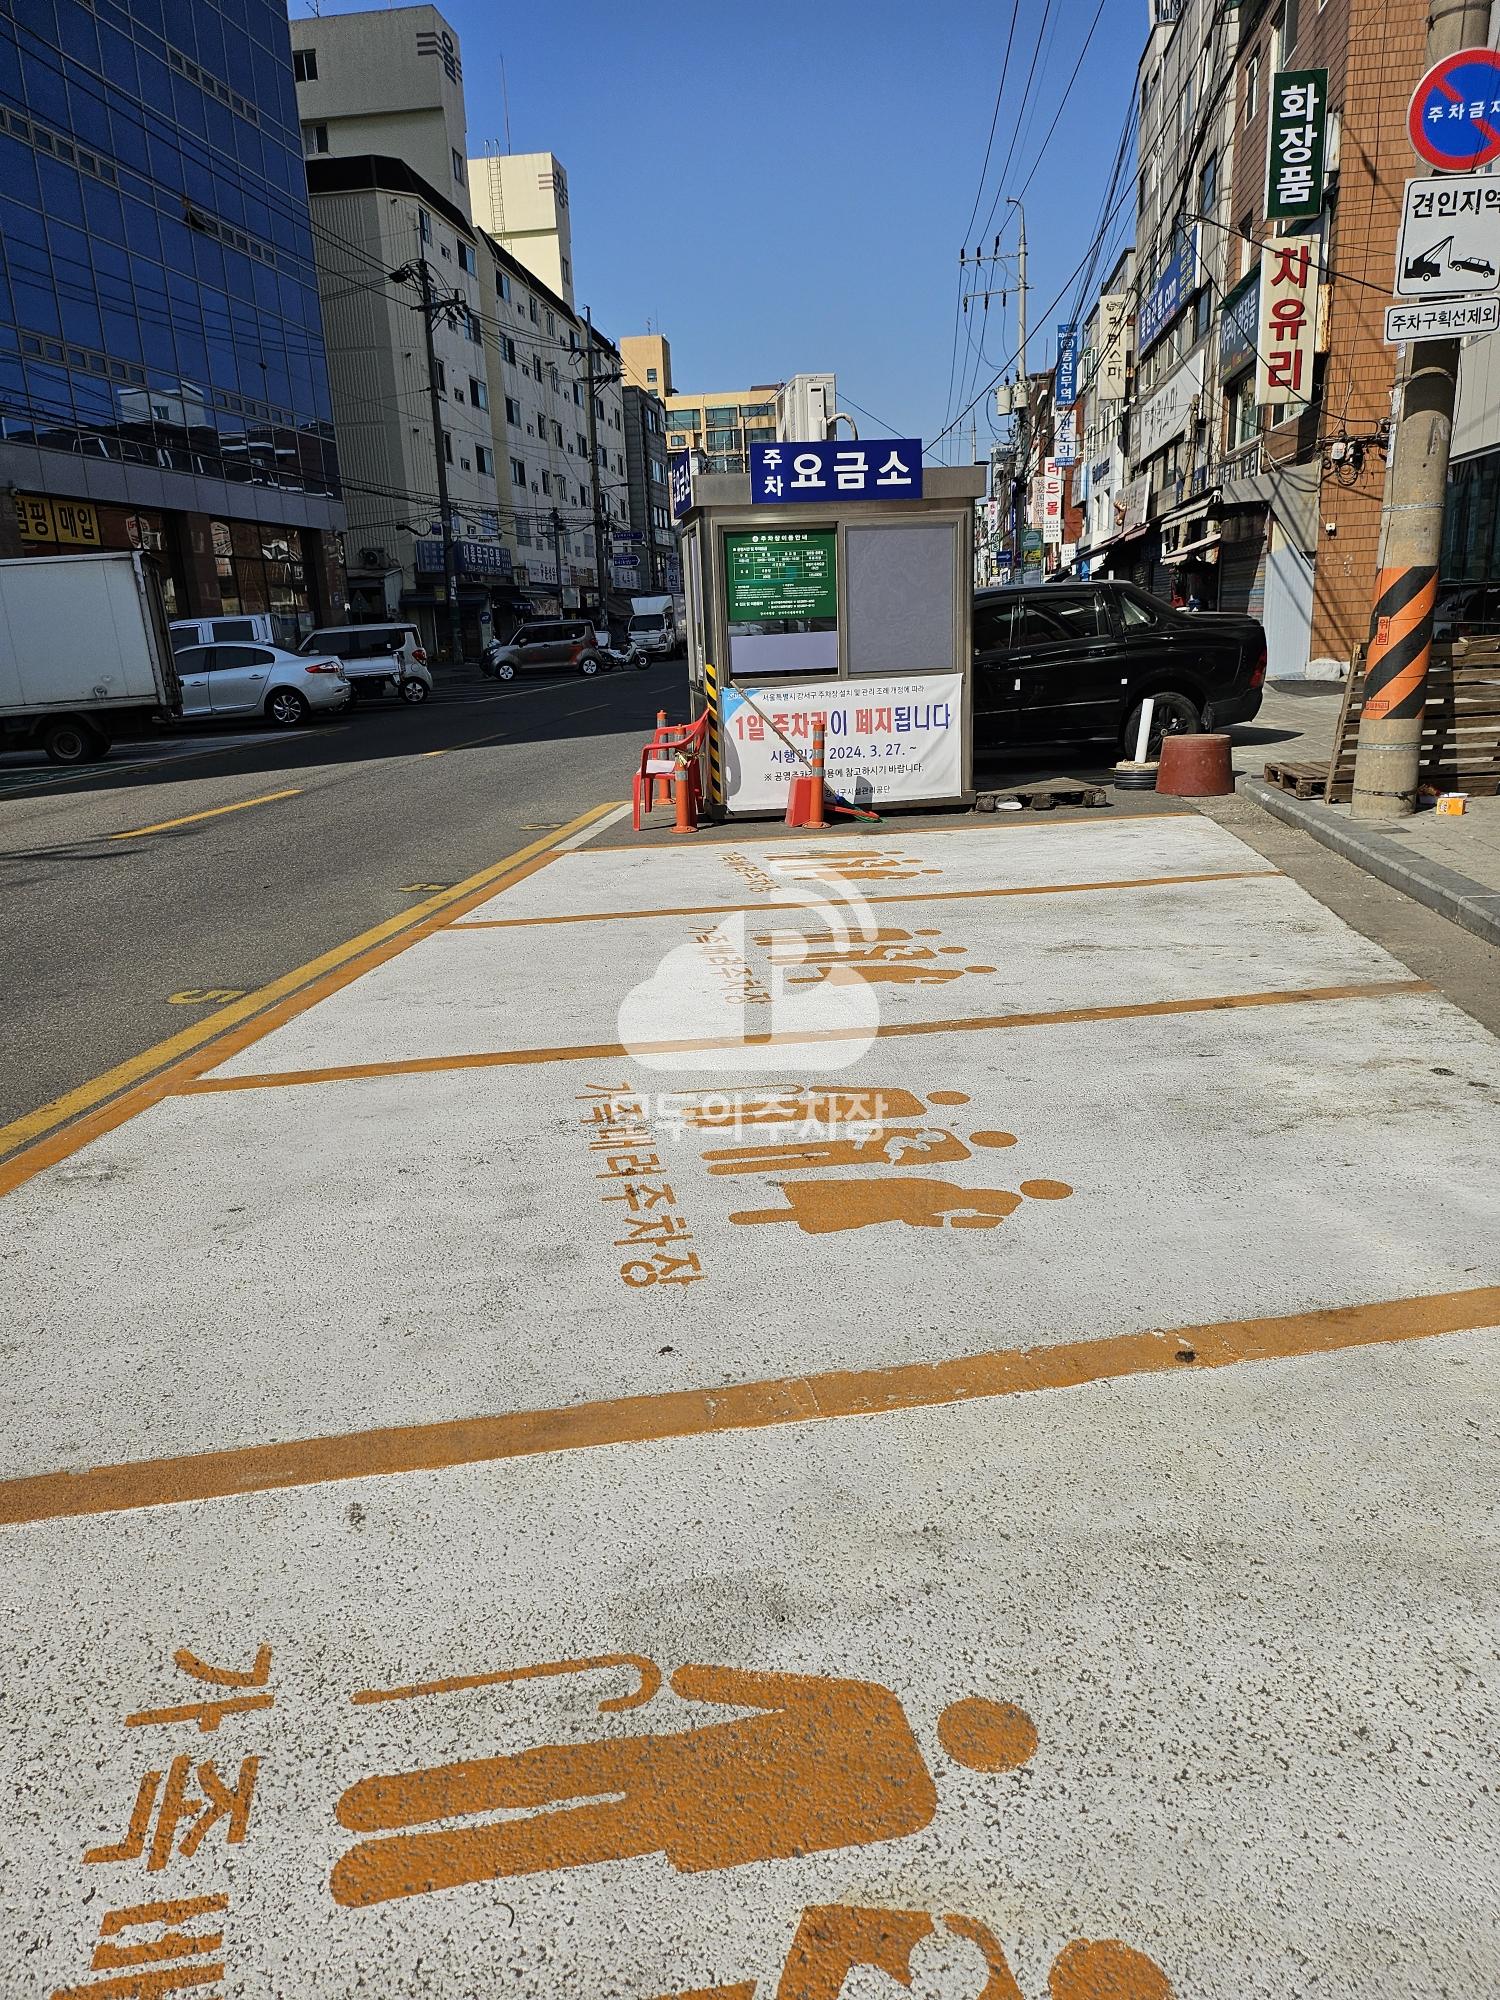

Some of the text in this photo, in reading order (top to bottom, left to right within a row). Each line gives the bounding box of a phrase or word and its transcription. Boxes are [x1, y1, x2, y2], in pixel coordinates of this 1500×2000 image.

[1276, 83, 1319, 204] 화장품
[1268, 245, 1312, 391] 차유리
[1391, 306, 1497, 333] 주차구획선제외
[791, 450, 912, 490] 요금소
[58, 506, 96, 540] 매입
[1378, 619, 1388, 643] 위험
[762, 693, 796, 702] 서울특별시
[797, 691, 817, 700] 강서구
[818, 690, 838, 698] 주차장
[839, 689, 853, 697] 설치
[862, 688, 875, 697] 관리
[876, 687, 889, 695] 조례
[890, 686, 910, 694] 개정에
[911, 685, 925, 693] 따라
[735, 714, 765, 741] 1일
[855, 703, 950, 735] 폐지됩니다
[829, 746, 866, 760] 2024.
[870, 744, 882, 757] 3.
[885, 743, 905, 756] 27.
[845, 765, 887, 777] 참고하시기
[888, 763, 924, 774] 바랍니다.
[574, 1081, 708, 1289] 가족배려주차장
